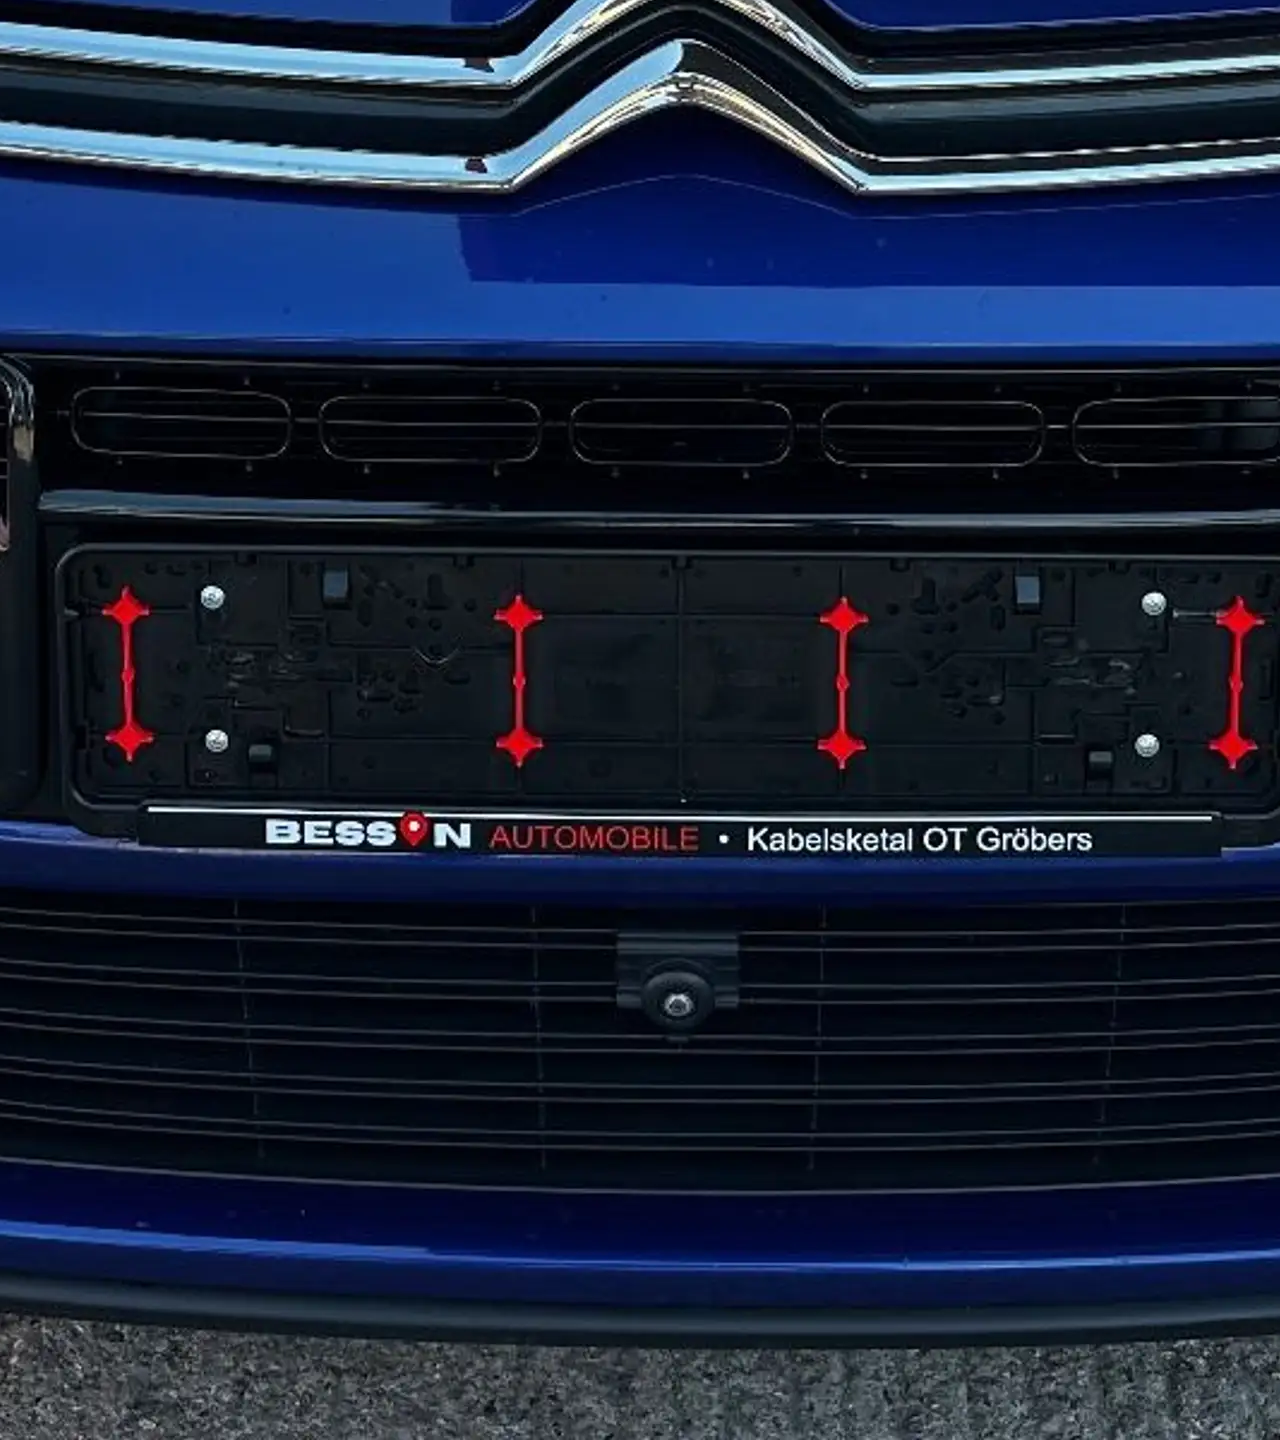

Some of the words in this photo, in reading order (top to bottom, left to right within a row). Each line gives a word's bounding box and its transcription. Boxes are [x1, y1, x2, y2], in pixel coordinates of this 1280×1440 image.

[489, 825, 700, 852] AUTOMOBILE
[747, 826, 914, 853] Kabelsketal
[923, 827, 967, 853] OT
[976, 826, 1093, 853] Gröbers
